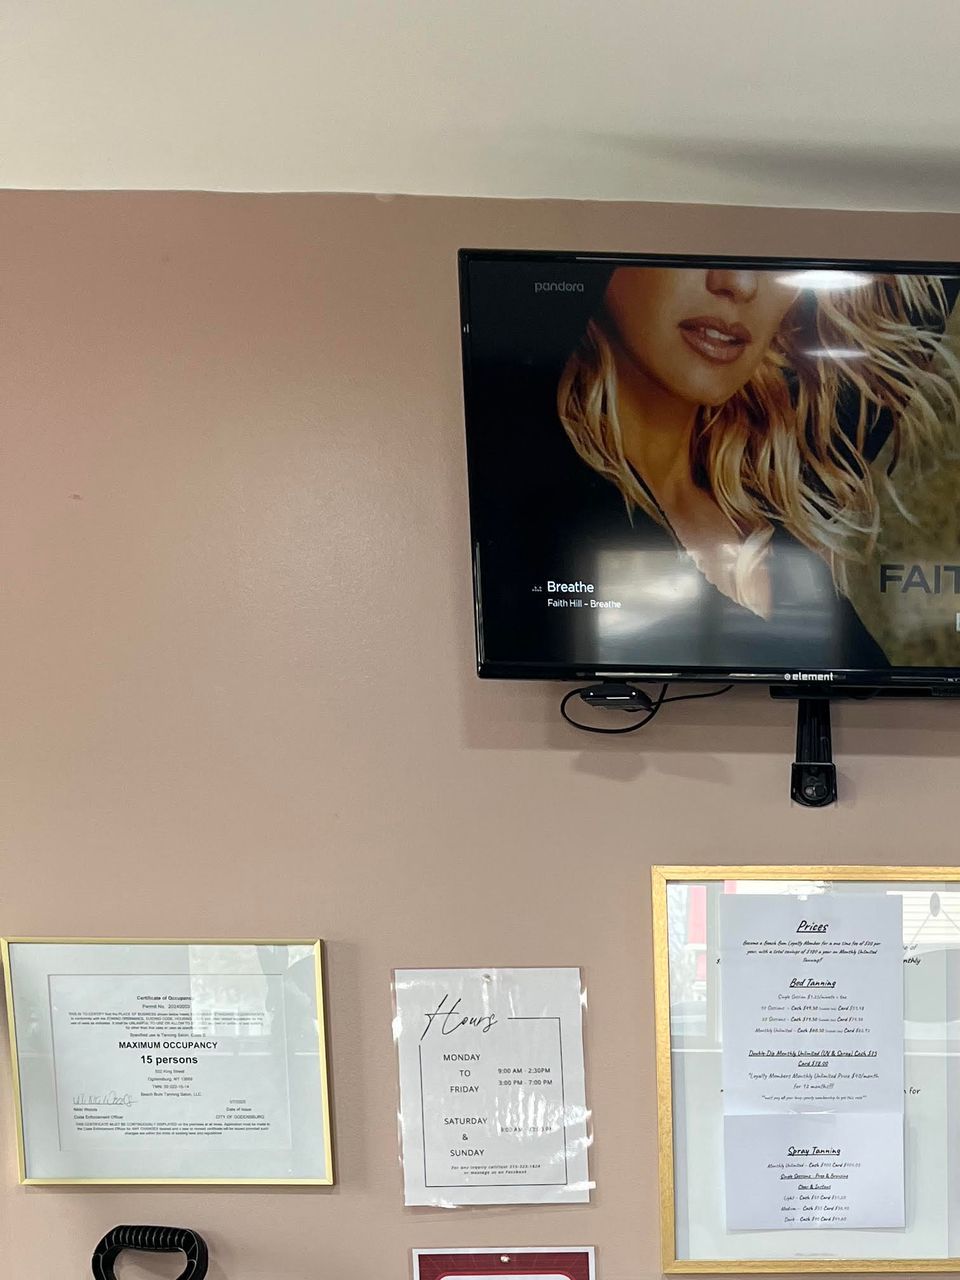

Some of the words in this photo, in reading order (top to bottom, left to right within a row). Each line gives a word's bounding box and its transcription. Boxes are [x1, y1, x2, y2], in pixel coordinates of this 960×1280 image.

[534, 282, 584, 293] pandora
[547, 581, 594, 593] Breathe
[548, 599, 568, 607] Faith
[569, 599, 582, 608] Hill
[591, 600, 622, 608] Breathe
[792, 672, 834, 681] element
[796, 920, 829, 933] Prices
[789, 978, 805, 988] Bed
[807, 979, 837, 988] Tanning
[420, 994, 498, 1041] Hours
[118, 1041, 160, 1049] MAXIMUM
[163, 1041, 218, 1049] OCCUPANCY
[141, 1056, 152, 1064] 15
[156, 1056, 198, 1065] persons
[909, 1087, 921, 1095] for
[788, 1146, 809, 1156] Spray
[812, 1147, 841, 1156] Tanning
